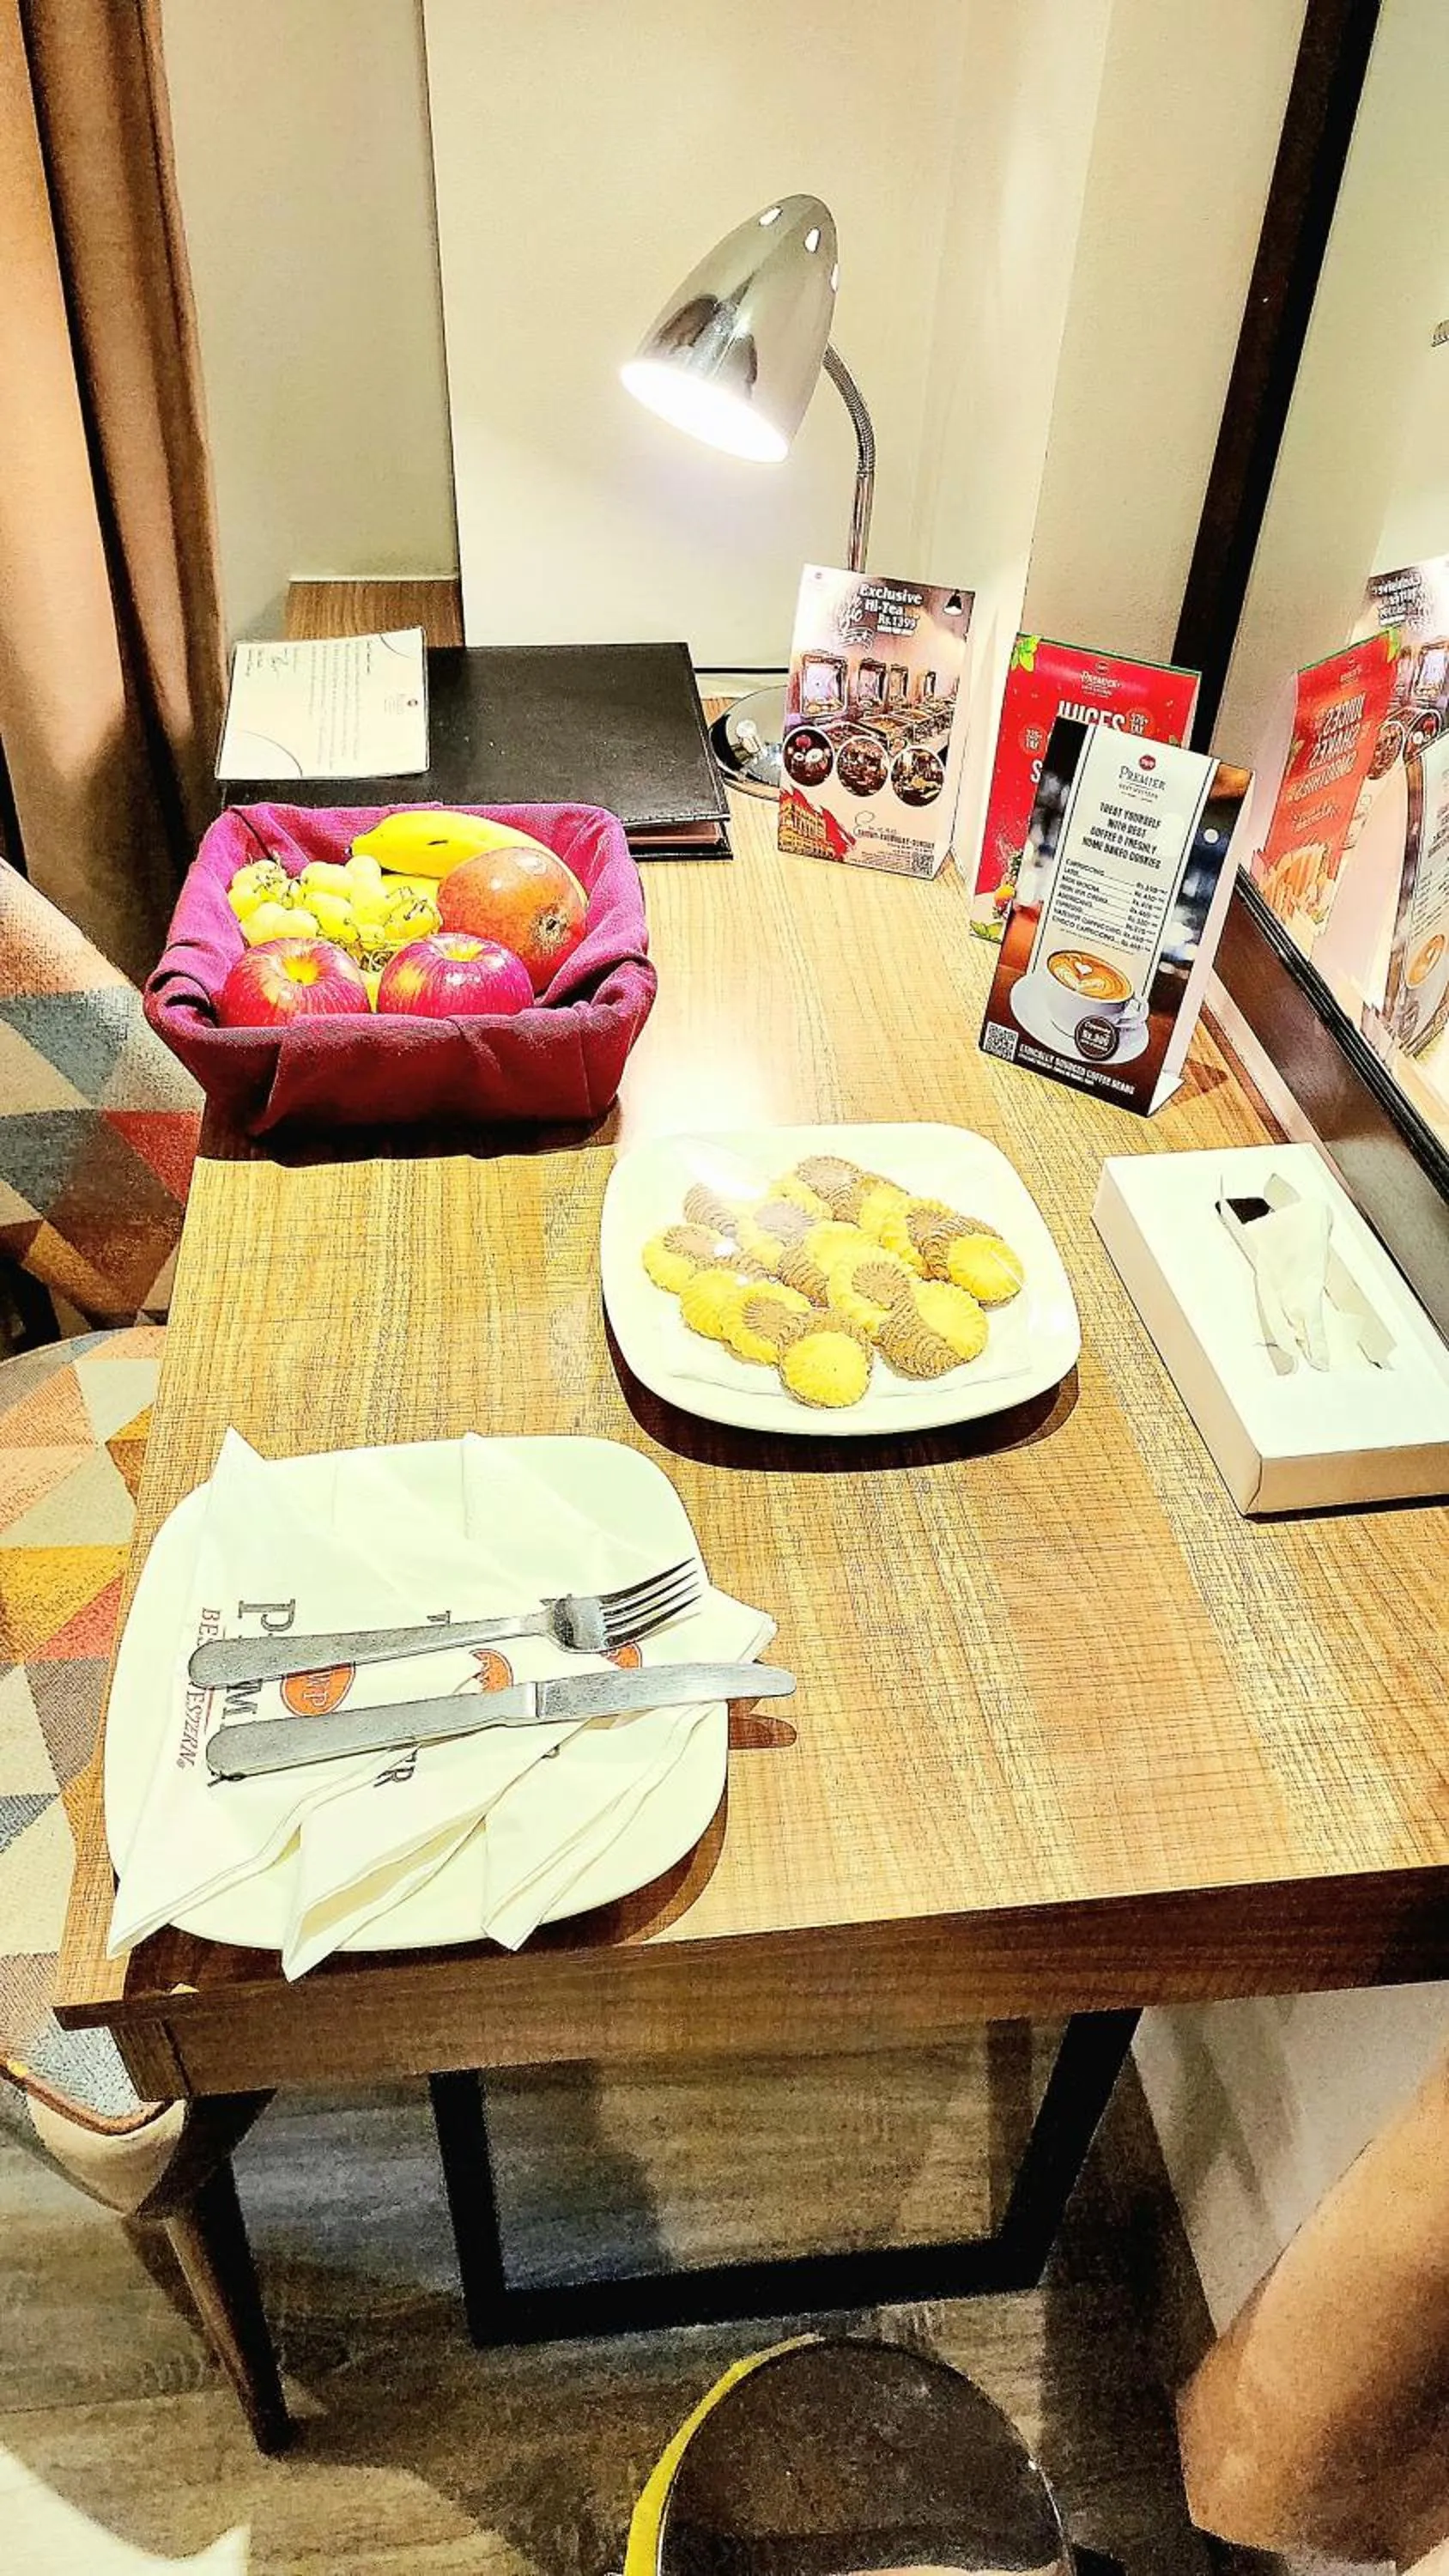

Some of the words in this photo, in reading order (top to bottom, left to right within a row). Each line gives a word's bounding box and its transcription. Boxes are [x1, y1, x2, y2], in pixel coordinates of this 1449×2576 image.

[859, 584, 923, 605] Exclusive
[1119, 765, 1167, 790] PREMIER
[1100, 801, 1123, 817] TREAT
[1124, 809, 1161, 829] YOURSELF
[1089, 825, 1117, 842] COFFEE
[1129, 851, 1161, 870] COOKIES
[1086, 1068, 1113, 1087] COFFEE
